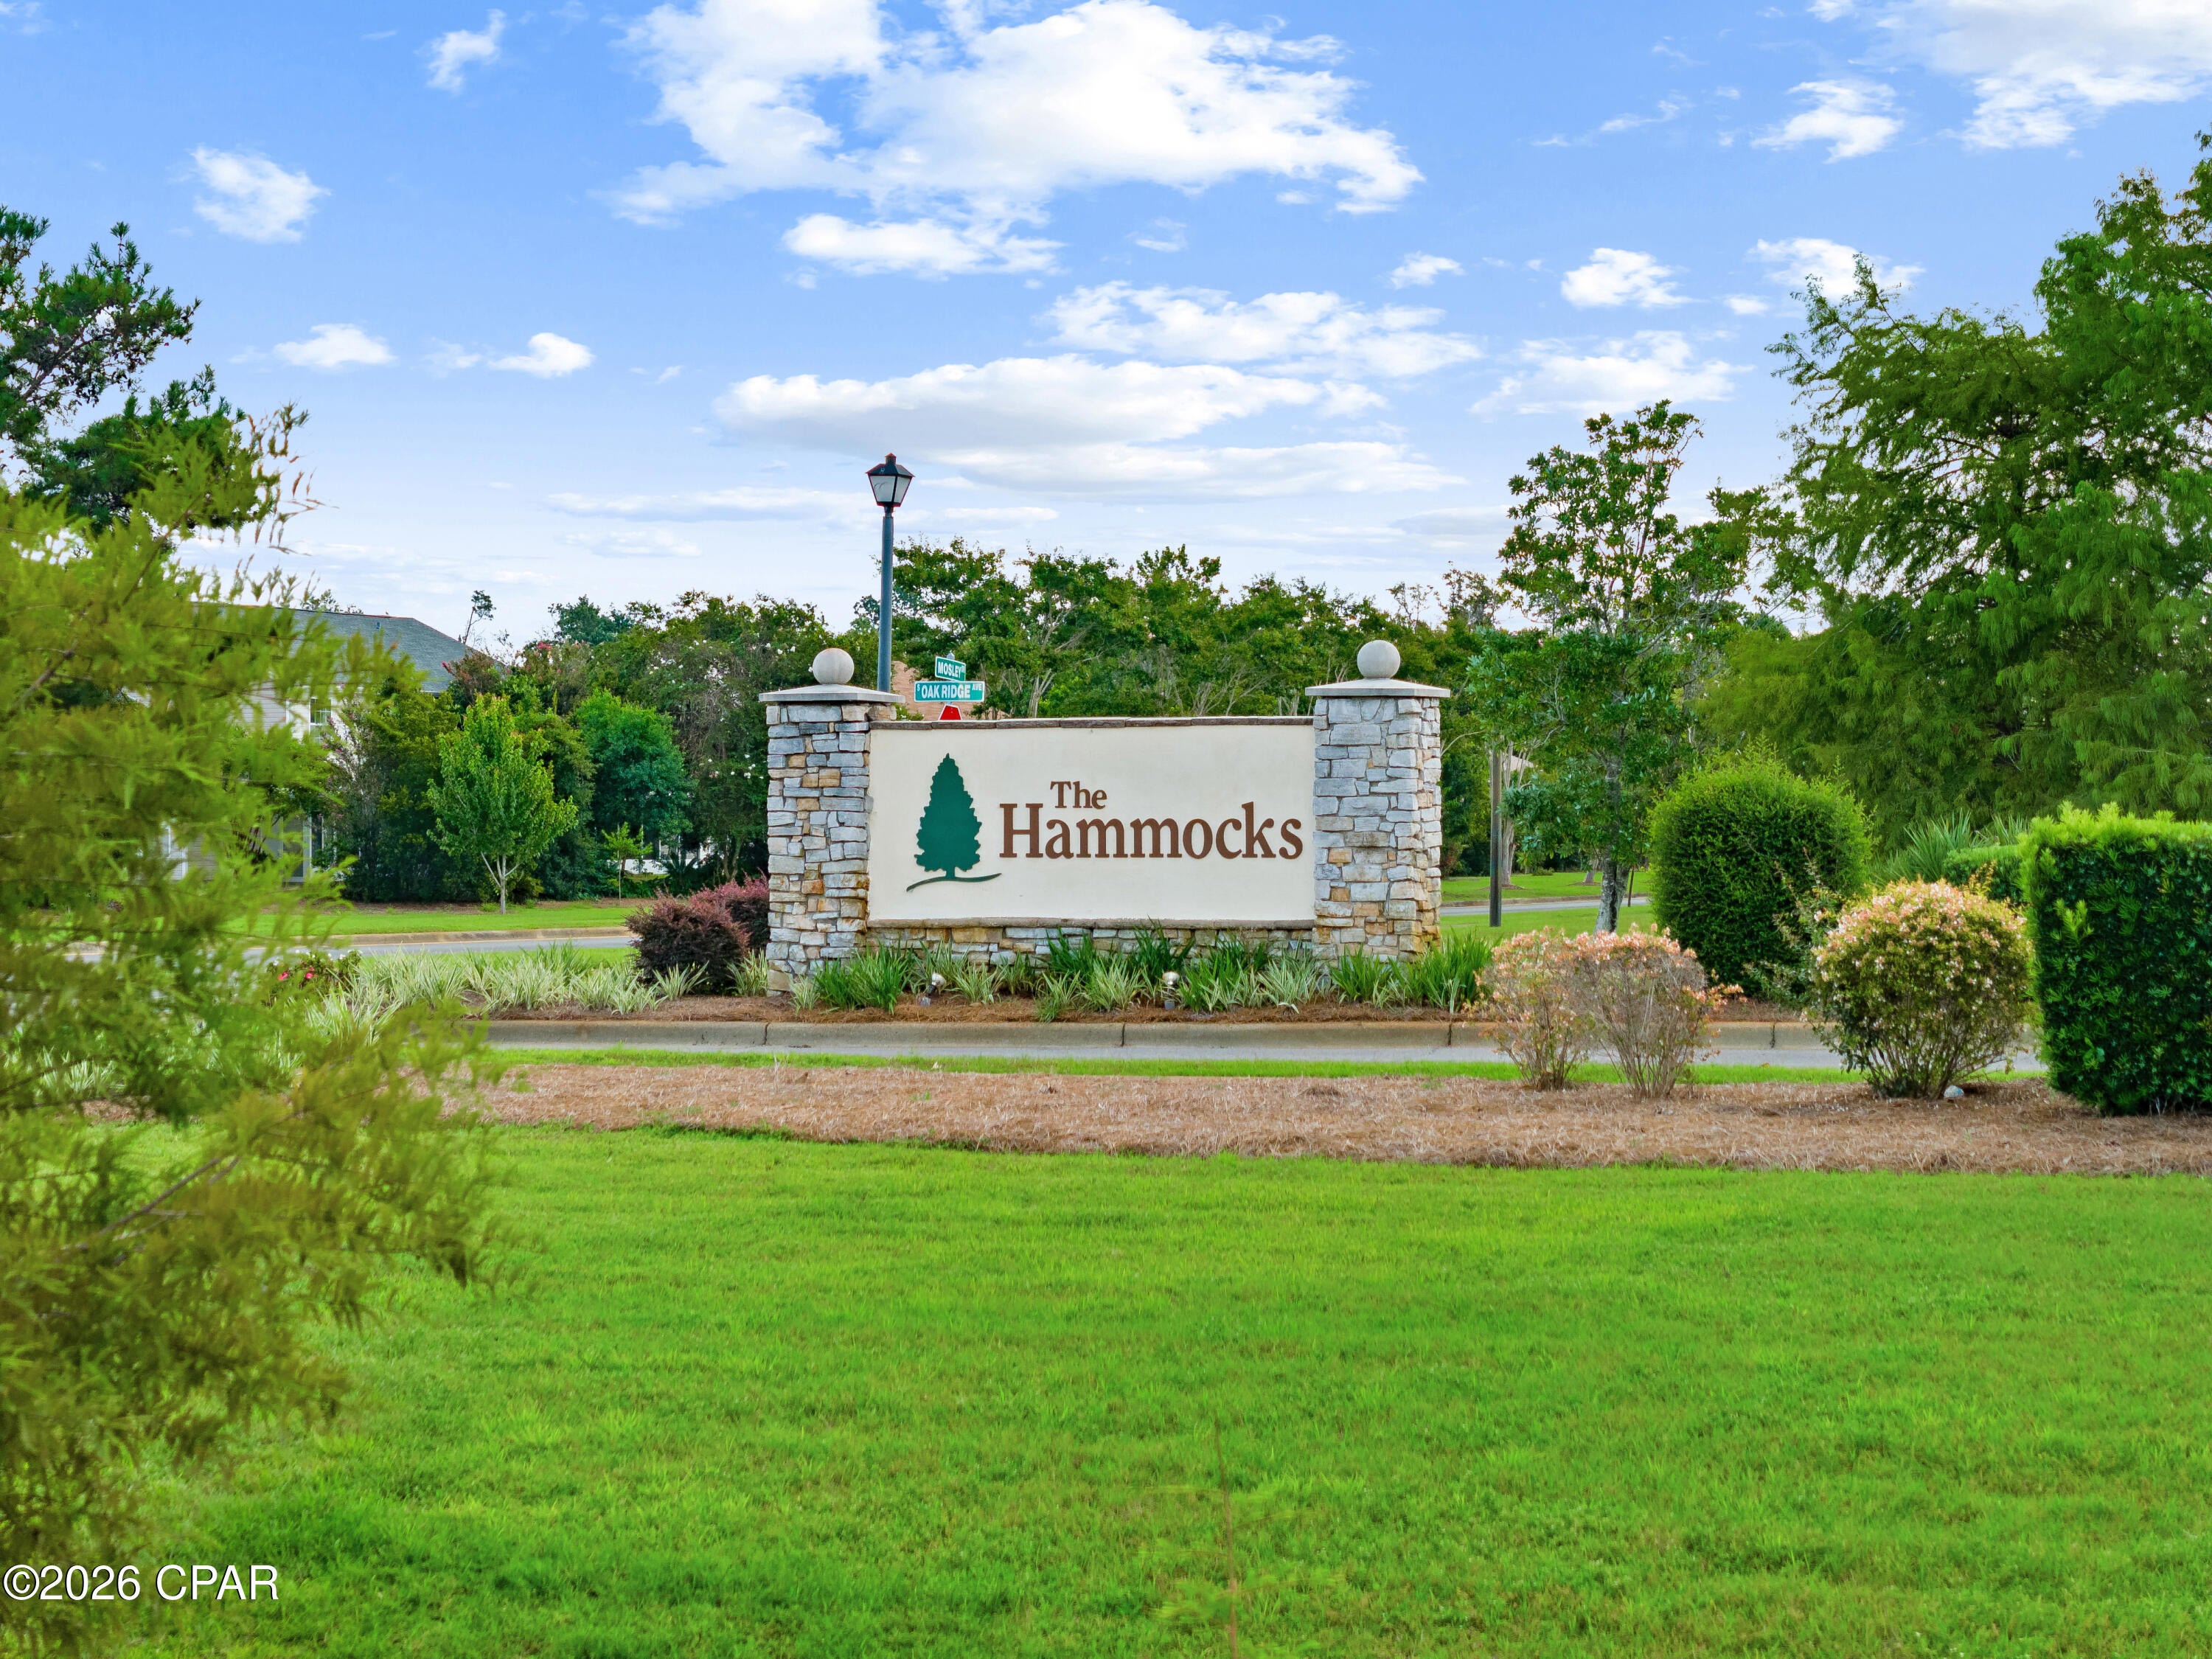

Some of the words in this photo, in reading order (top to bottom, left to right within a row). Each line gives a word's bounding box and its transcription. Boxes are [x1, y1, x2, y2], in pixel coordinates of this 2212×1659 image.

[938, 661, 961, 678] MOSLEY
[917, 684, 921, 692] S
[921, 684, 940, 699] OAK
[941, 684, 970, 699] RIDGE
[972, 683, 982, 691] AVE
[1049, 781, 1107, 810] The
[999, 801, 1304, 860] Hammocks
